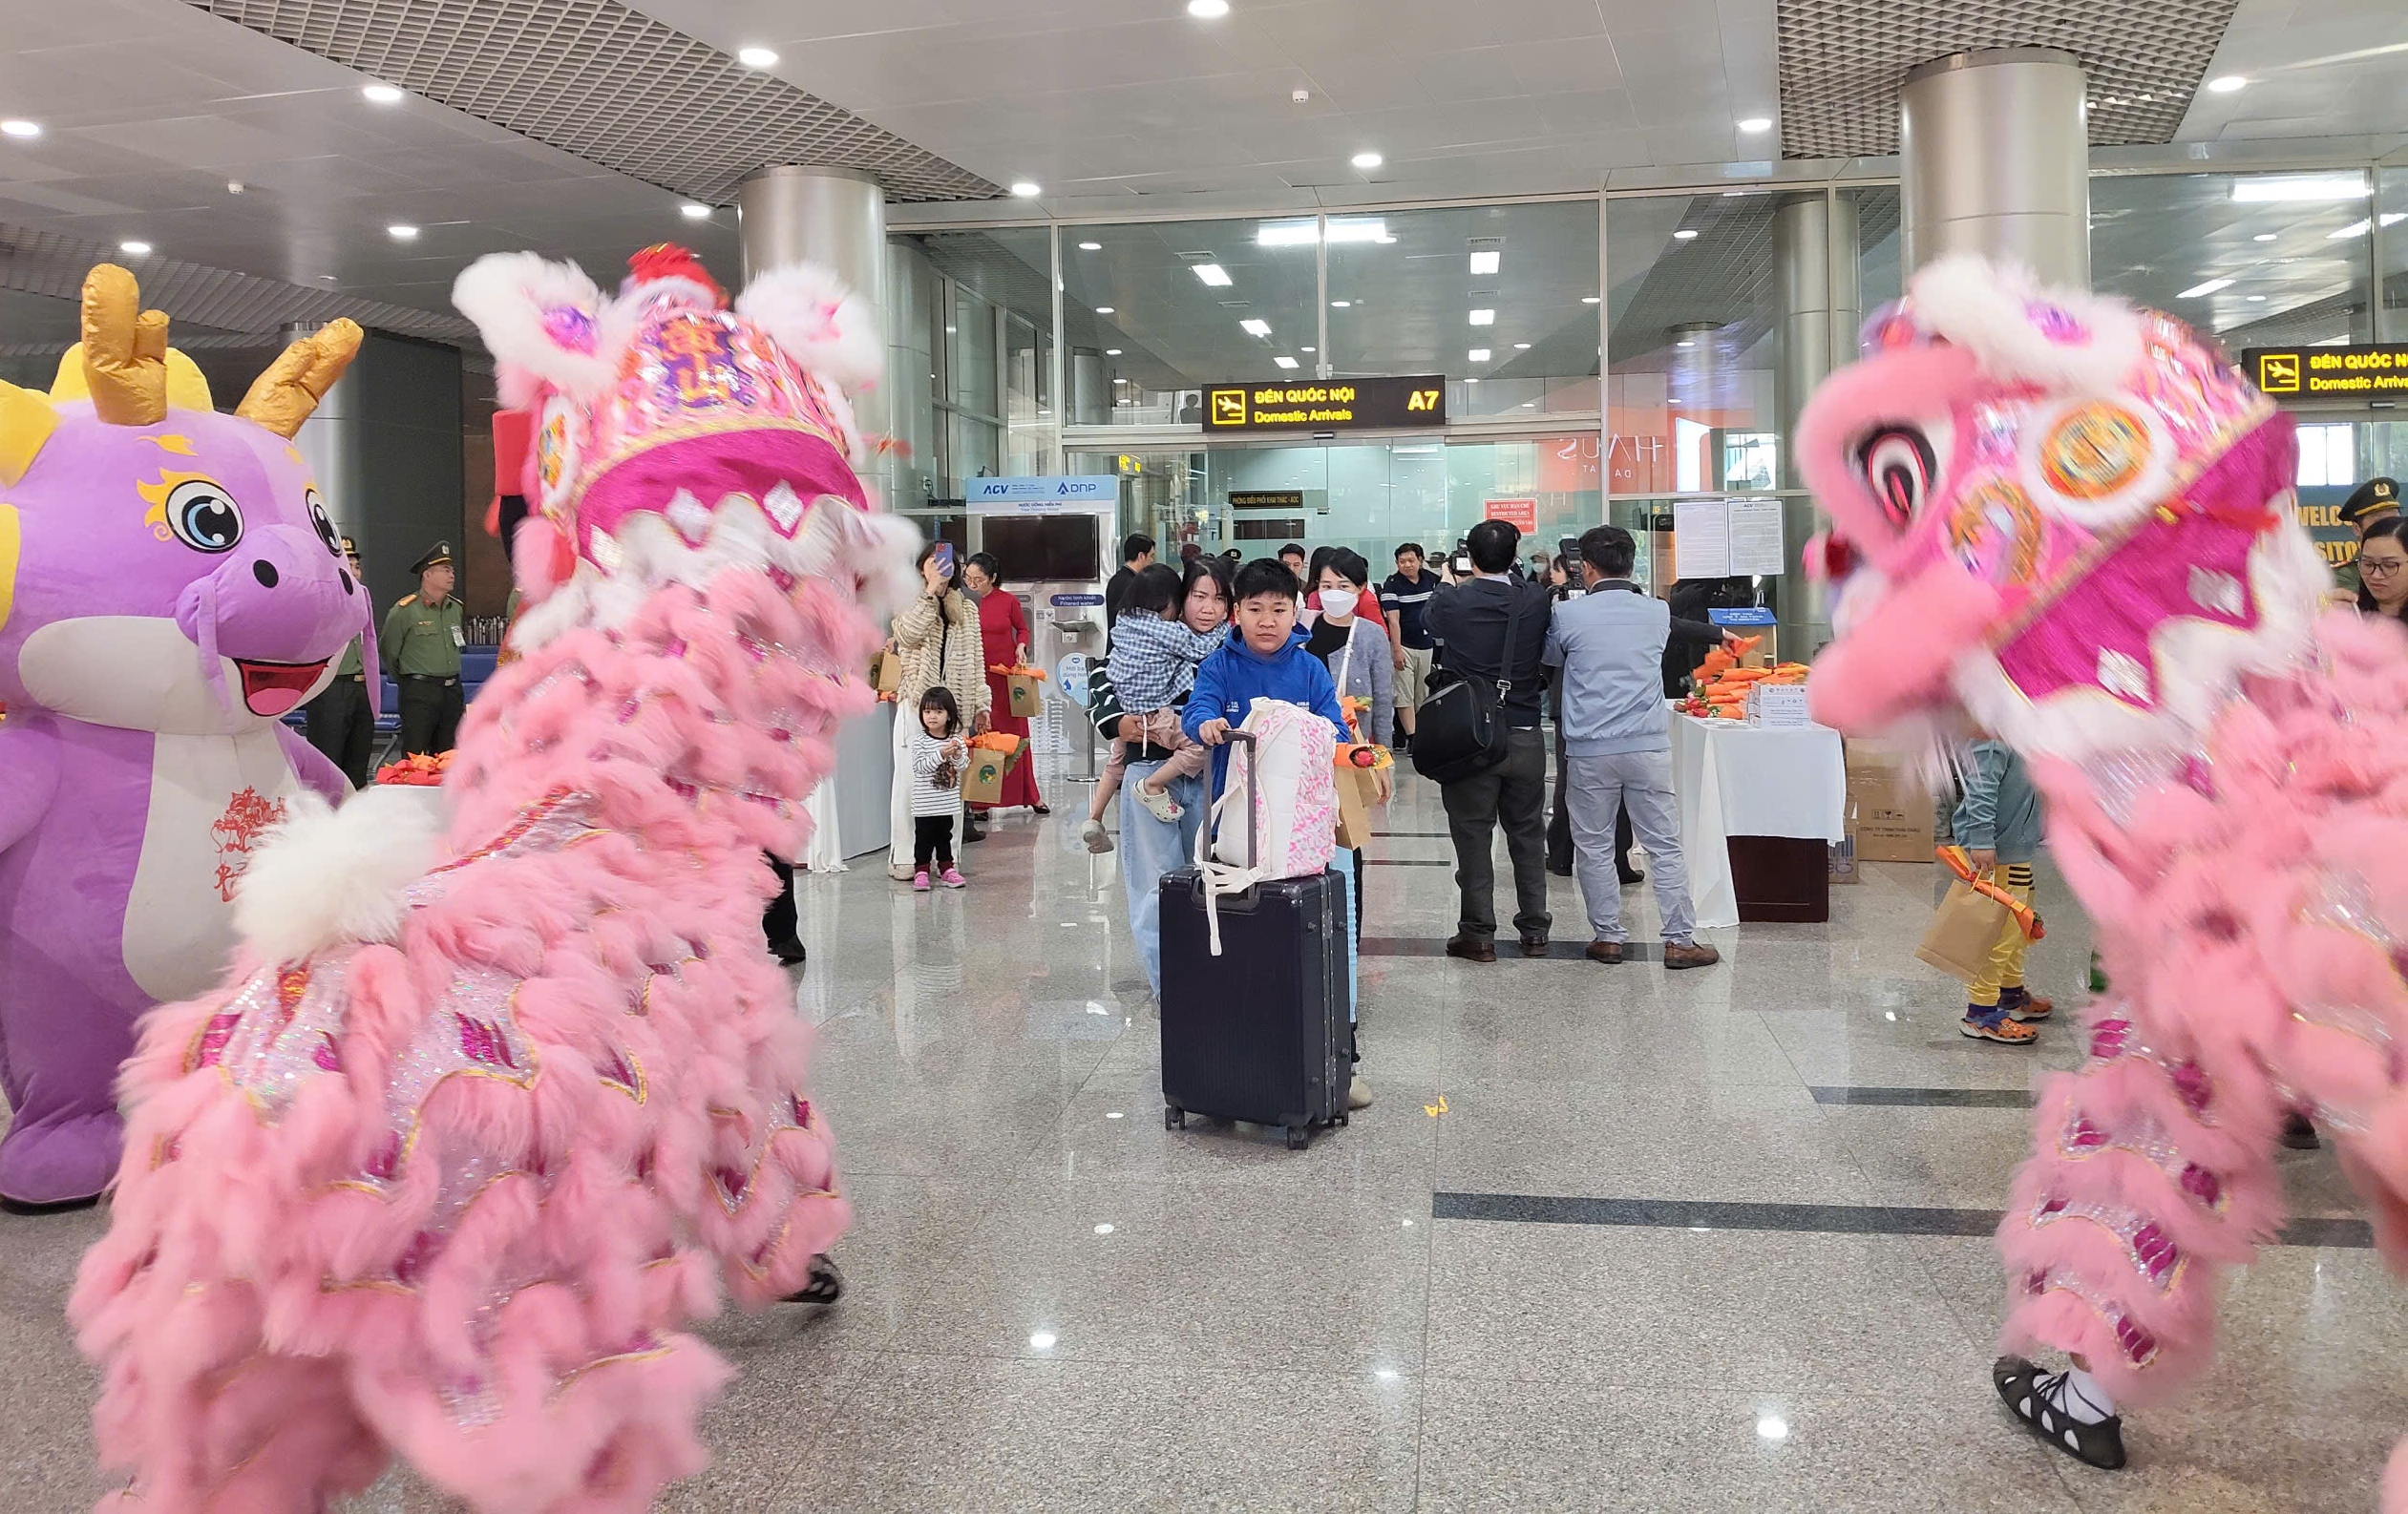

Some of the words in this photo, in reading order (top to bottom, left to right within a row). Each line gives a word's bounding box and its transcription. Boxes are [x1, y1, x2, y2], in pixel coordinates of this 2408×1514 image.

[2344, 351, 2392, 369] QUỐC
[2310, 376, 2372, 390] Domestic
[2374, 375, 2408, 389] Arriva
[1286, 387, 1327, 403] QUỐC
[1329, 386, 1355, 403] NỘI
[1407, 390, 1440, 411] A7
[1254, 410, 1308, 423] Domestic
[1310, 409, 1353, 422] Arrivals
[983, 485, 1009, 494] ACV
